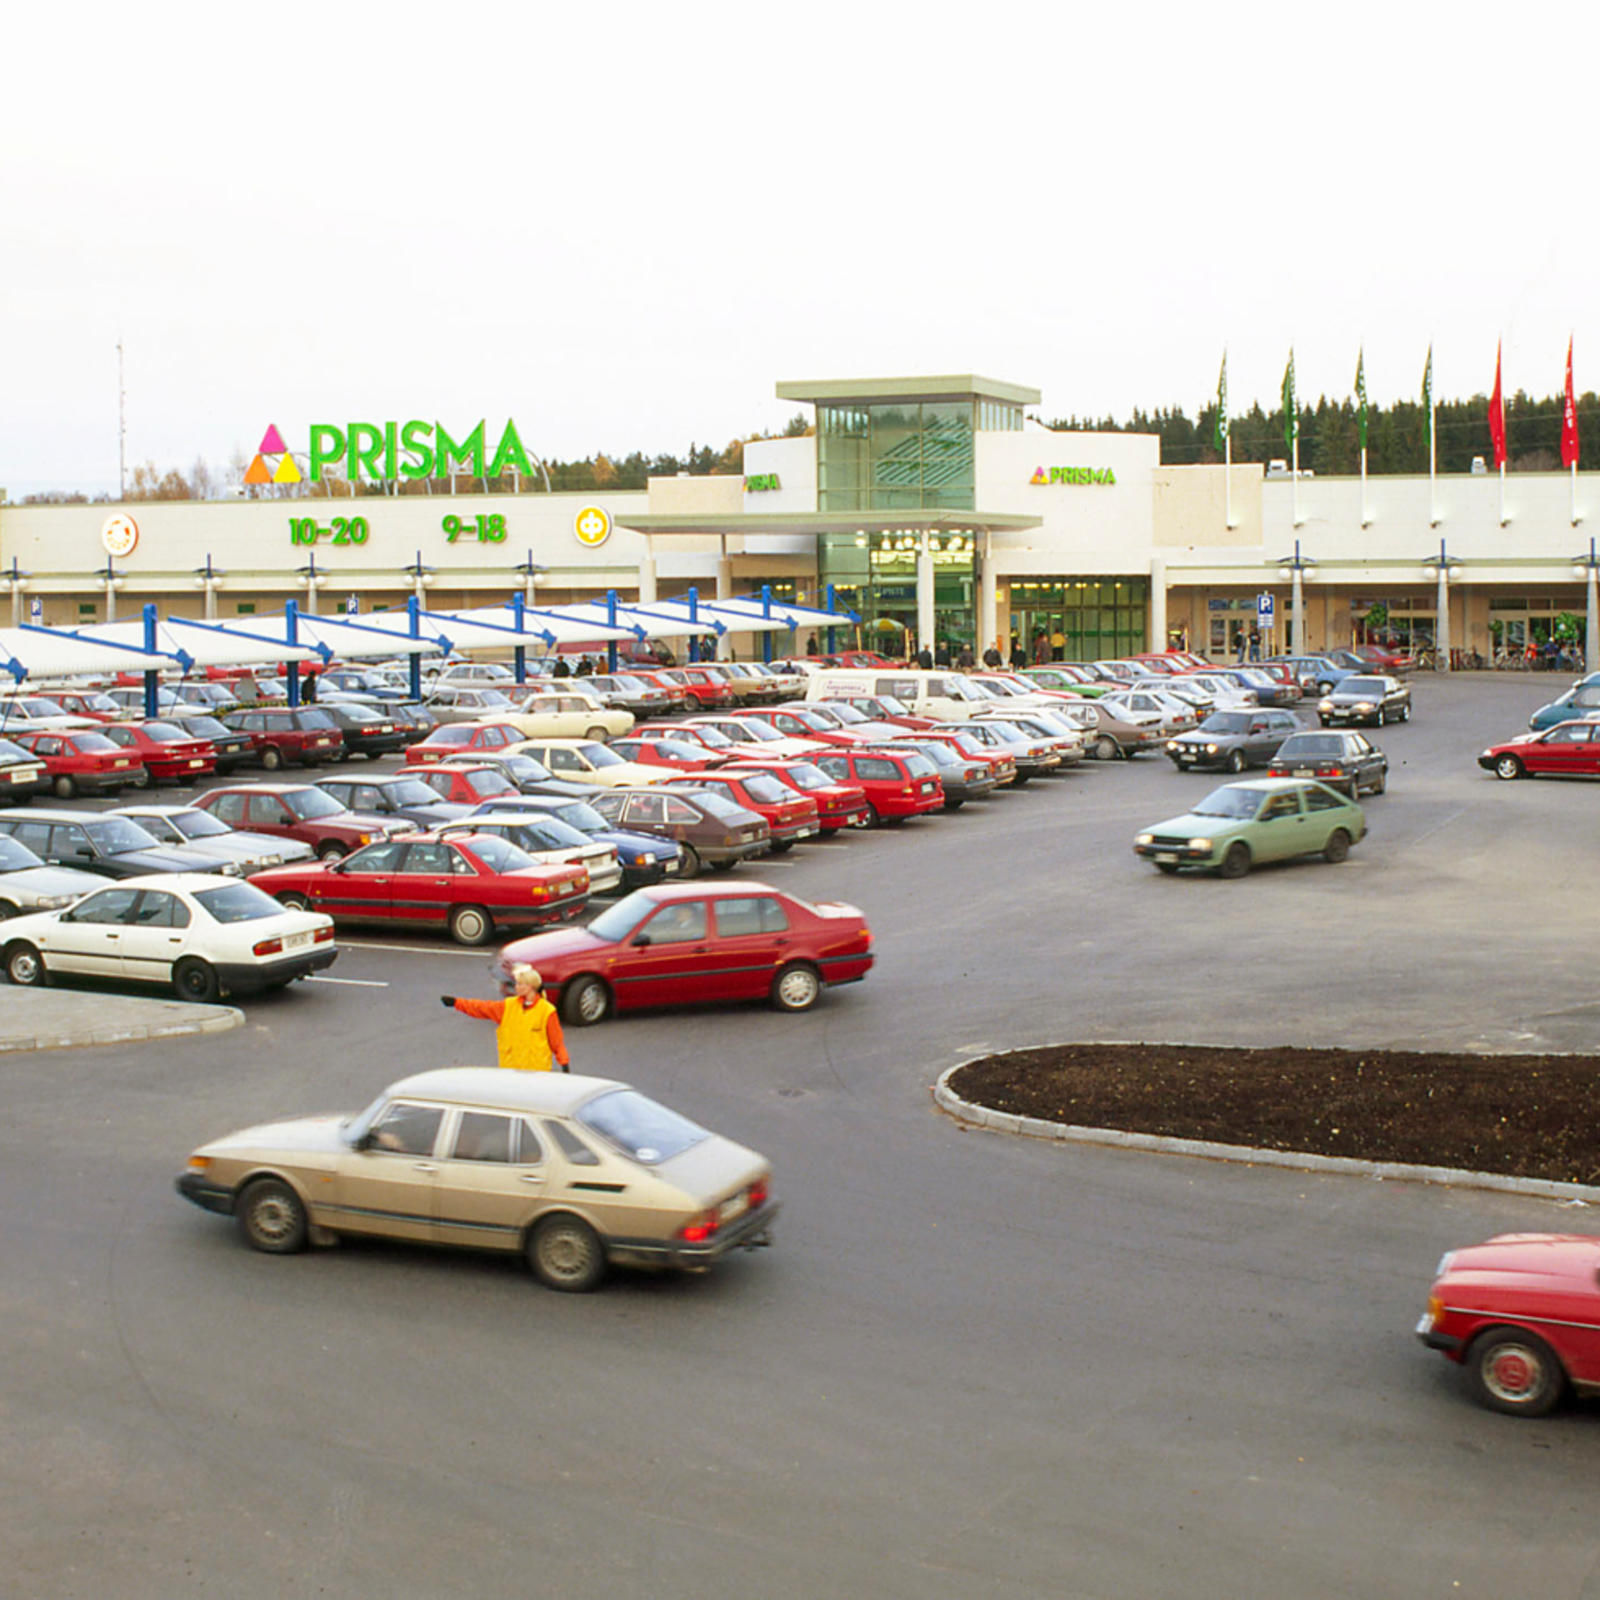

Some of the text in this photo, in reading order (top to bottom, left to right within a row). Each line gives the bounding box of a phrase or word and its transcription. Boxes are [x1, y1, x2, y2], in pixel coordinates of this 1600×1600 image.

[309, 418, 536, 482] PRISMA
[1049, 466, 1117, 485] PRISMA
[288, 516, 369, 546] 10-20
[441, 514, 507, 543] 9-18
[1260, 598, 1271, 611] P
